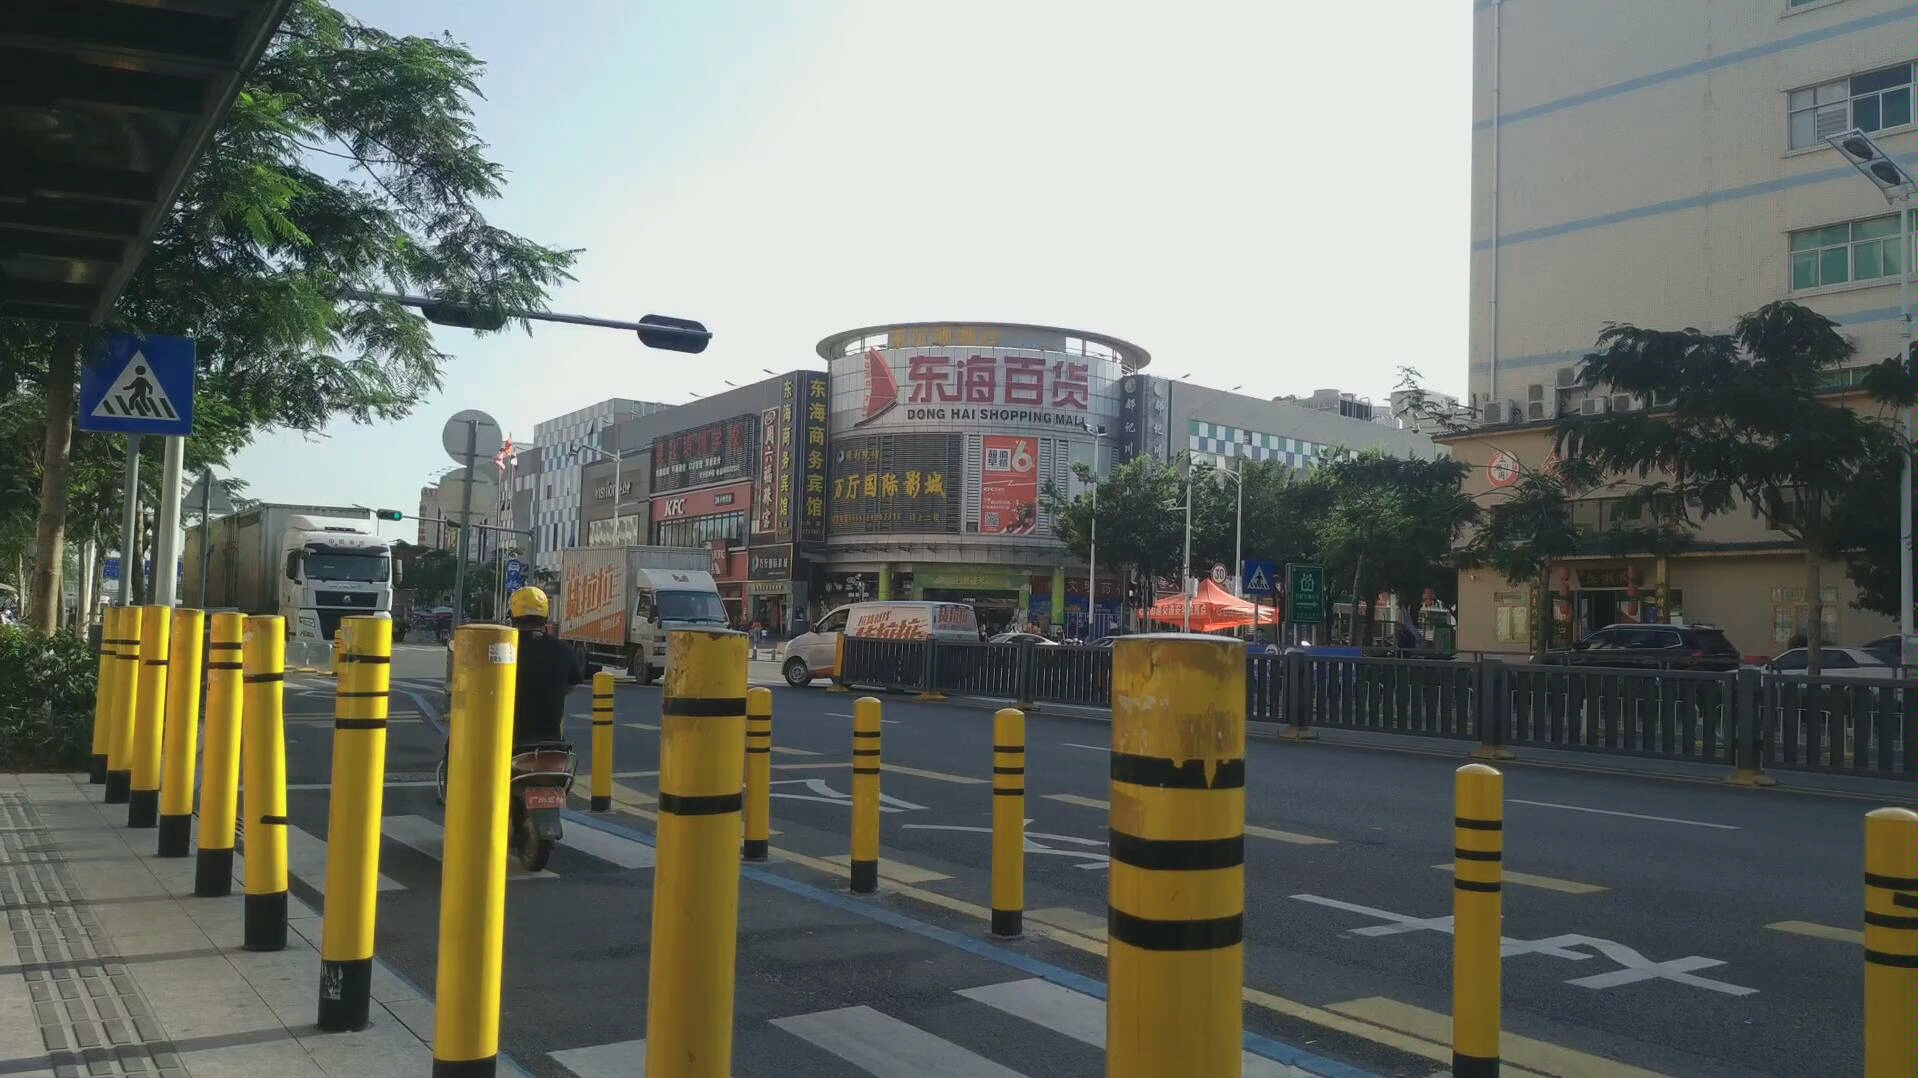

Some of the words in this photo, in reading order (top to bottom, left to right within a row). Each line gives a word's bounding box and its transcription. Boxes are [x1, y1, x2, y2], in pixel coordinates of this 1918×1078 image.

[907, 355, 1089, 410] 东海百货
[907, 408, 946, 421] DONG
[951, 408, 976, 421] HAI
[979, 408, 1052, 424] SHOPPING
[1055, 413, 1086, 426] MALL
[780, 379, 793, 517] 东海商务宾馆
[806, 379, 826, 518] 东海商务宾馆
[1012, 440, 1033, 472] 6
[664, 498, 688, 517] KFC
[1214, 568, 1226, 579] 30
